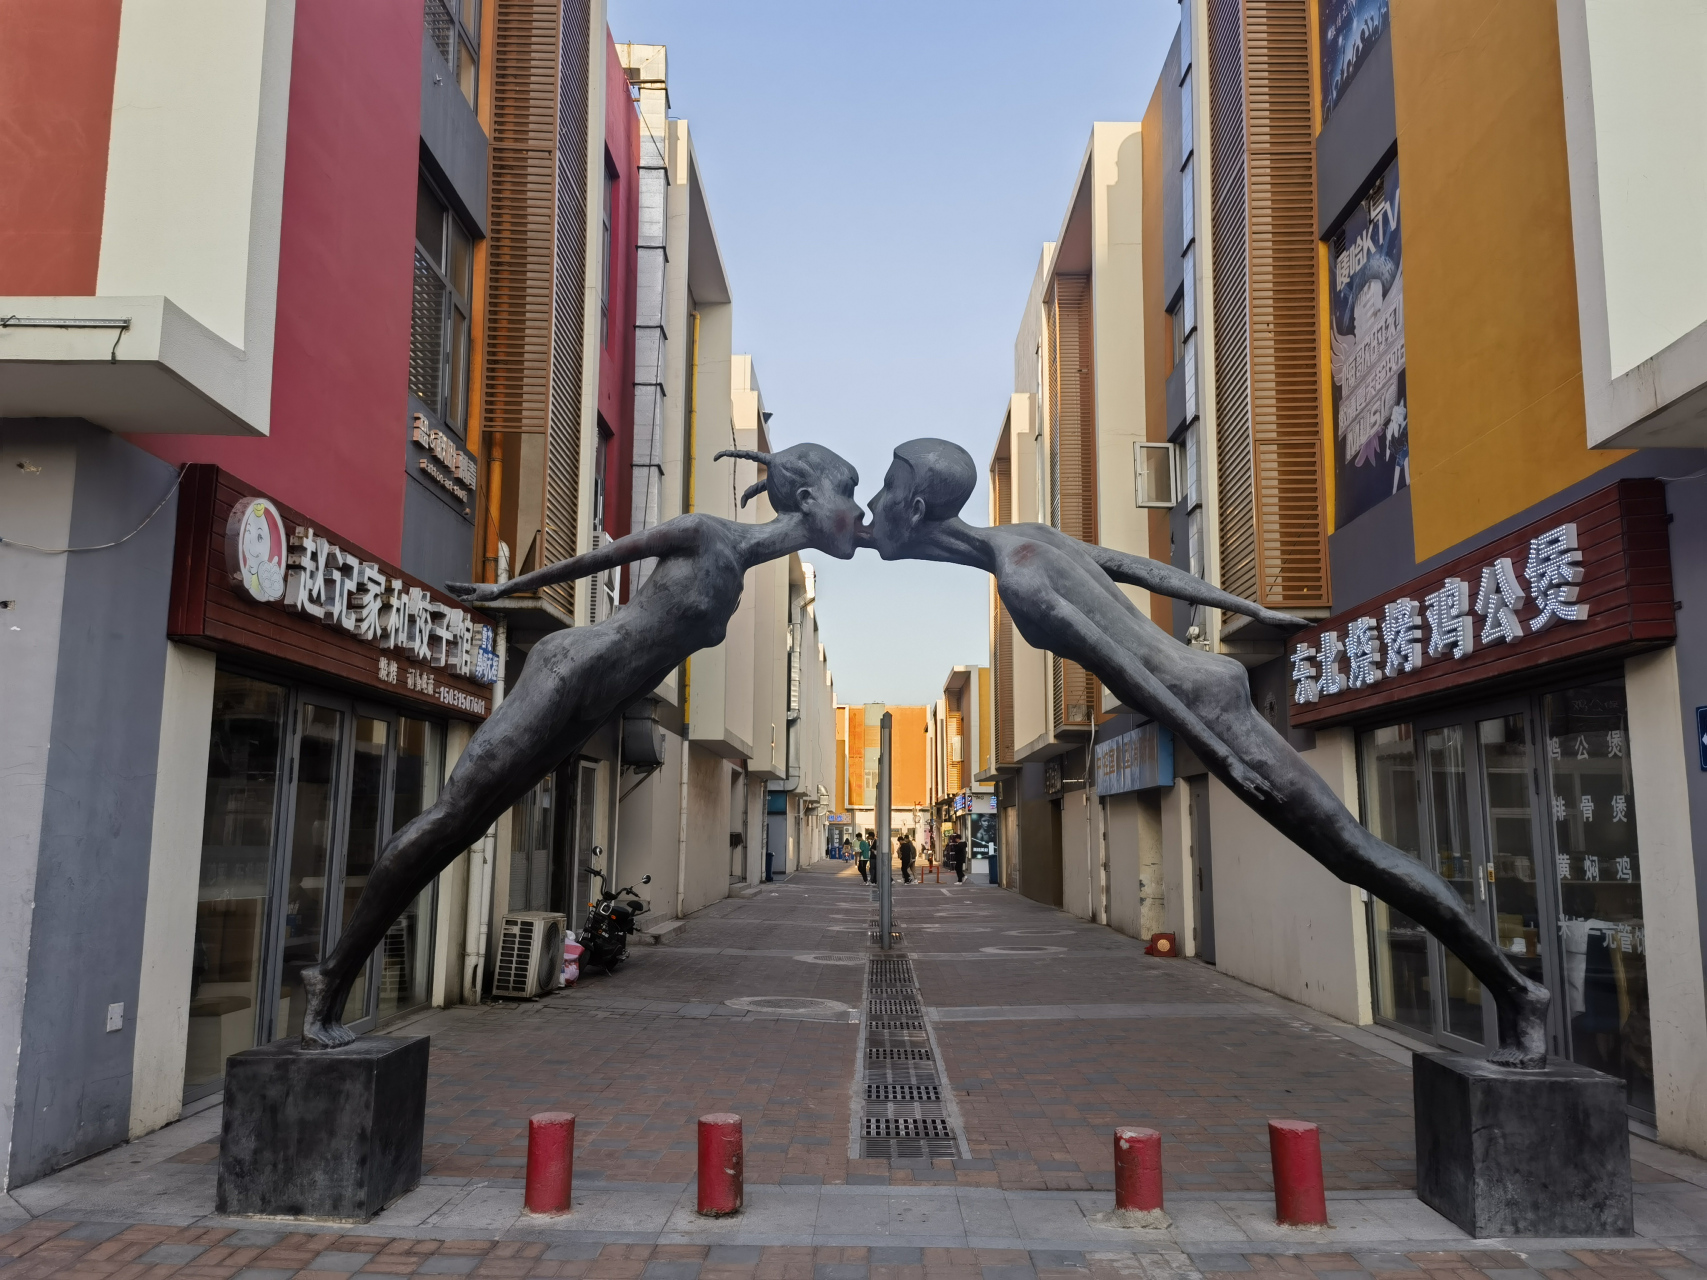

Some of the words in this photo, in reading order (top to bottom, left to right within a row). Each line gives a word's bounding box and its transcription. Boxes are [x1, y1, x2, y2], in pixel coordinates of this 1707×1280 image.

[289, 527, 473, 678] 赵记家和饺子馆
[1290, 523, 1589, 703] 东北烧烤鸡公煲
[378, 657, 398, 684] 烧烤
[1552, 794, 1628, 823] 排骨煲
[1557, 853, 1633, 884] 黄焖鸡
